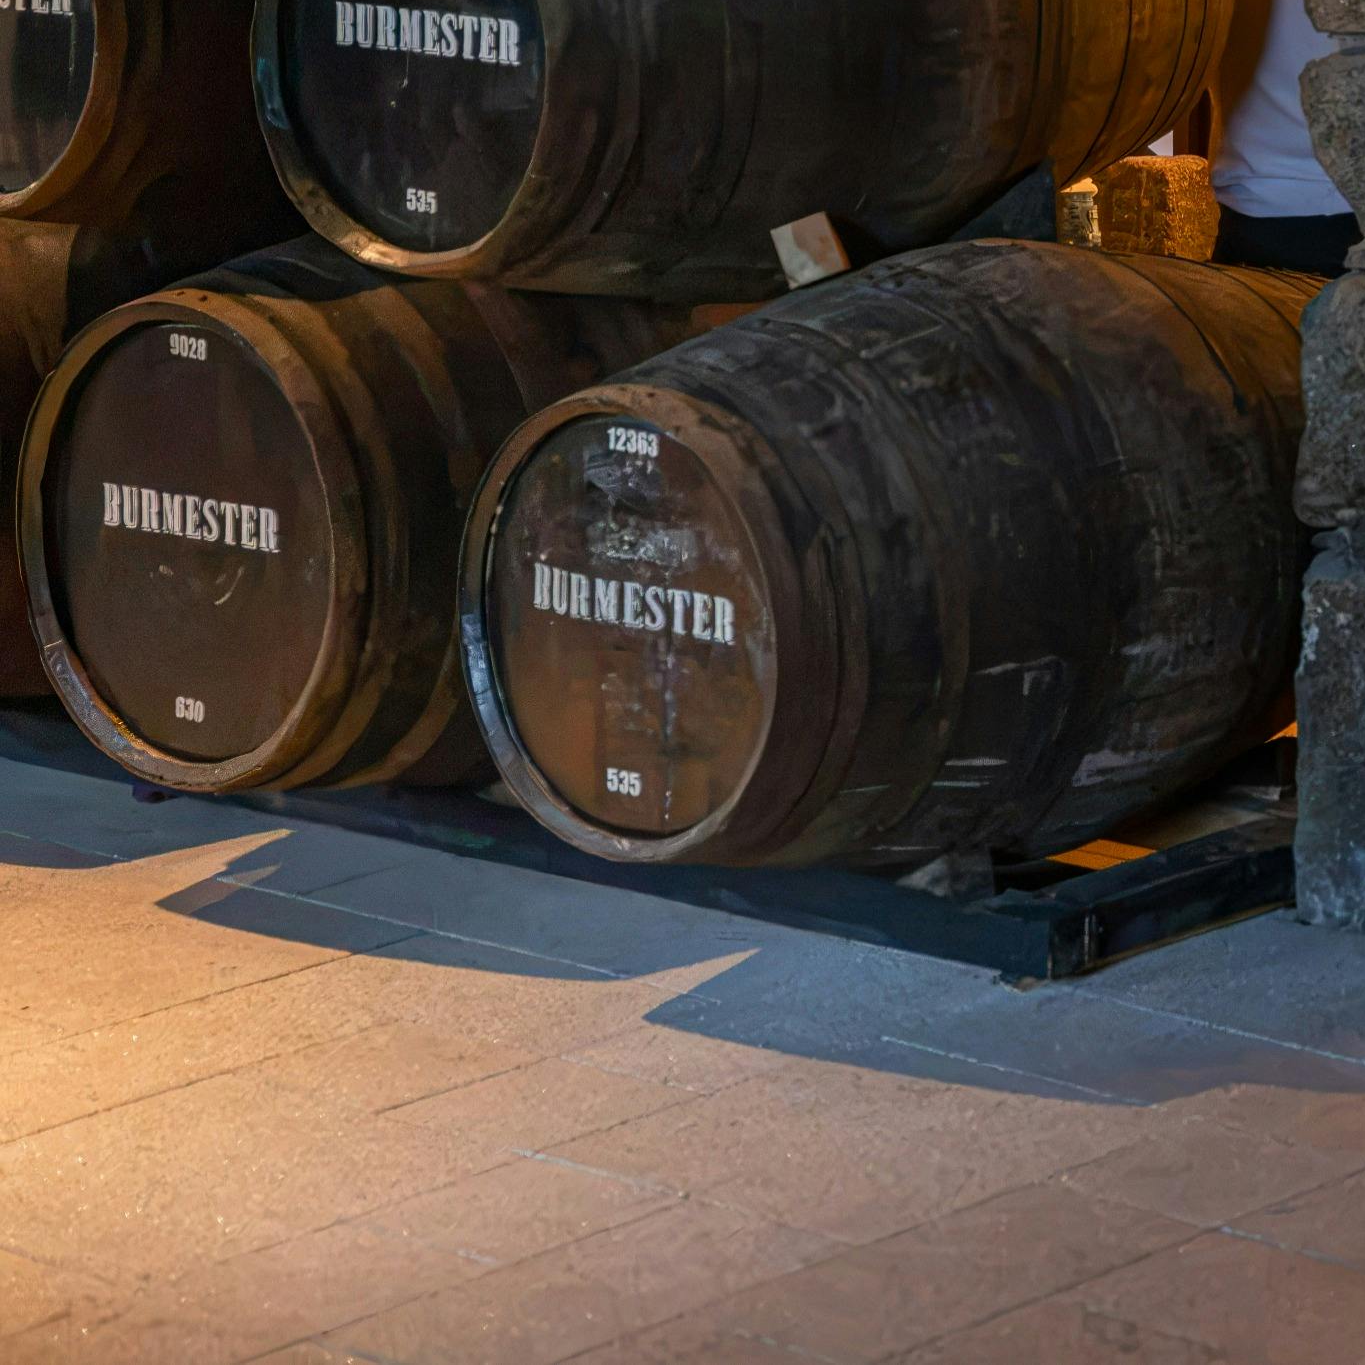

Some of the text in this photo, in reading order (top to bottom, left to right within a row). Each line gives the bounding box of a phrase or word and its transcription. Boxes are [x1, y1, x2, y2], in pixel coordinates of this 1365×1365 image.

[336, 1, 520, 66] BURMESTER
[406, 188, 438, 215] 535
[170, 333, 207, 361] 9028
[607, 427, 658, 458] 12363
[103, 482, 281, 553] BURMESTER
[533, 562, 735, 645] BURMESTER
[175, 696, 205, 723] 630
[606, 767, 642, 797] 535
